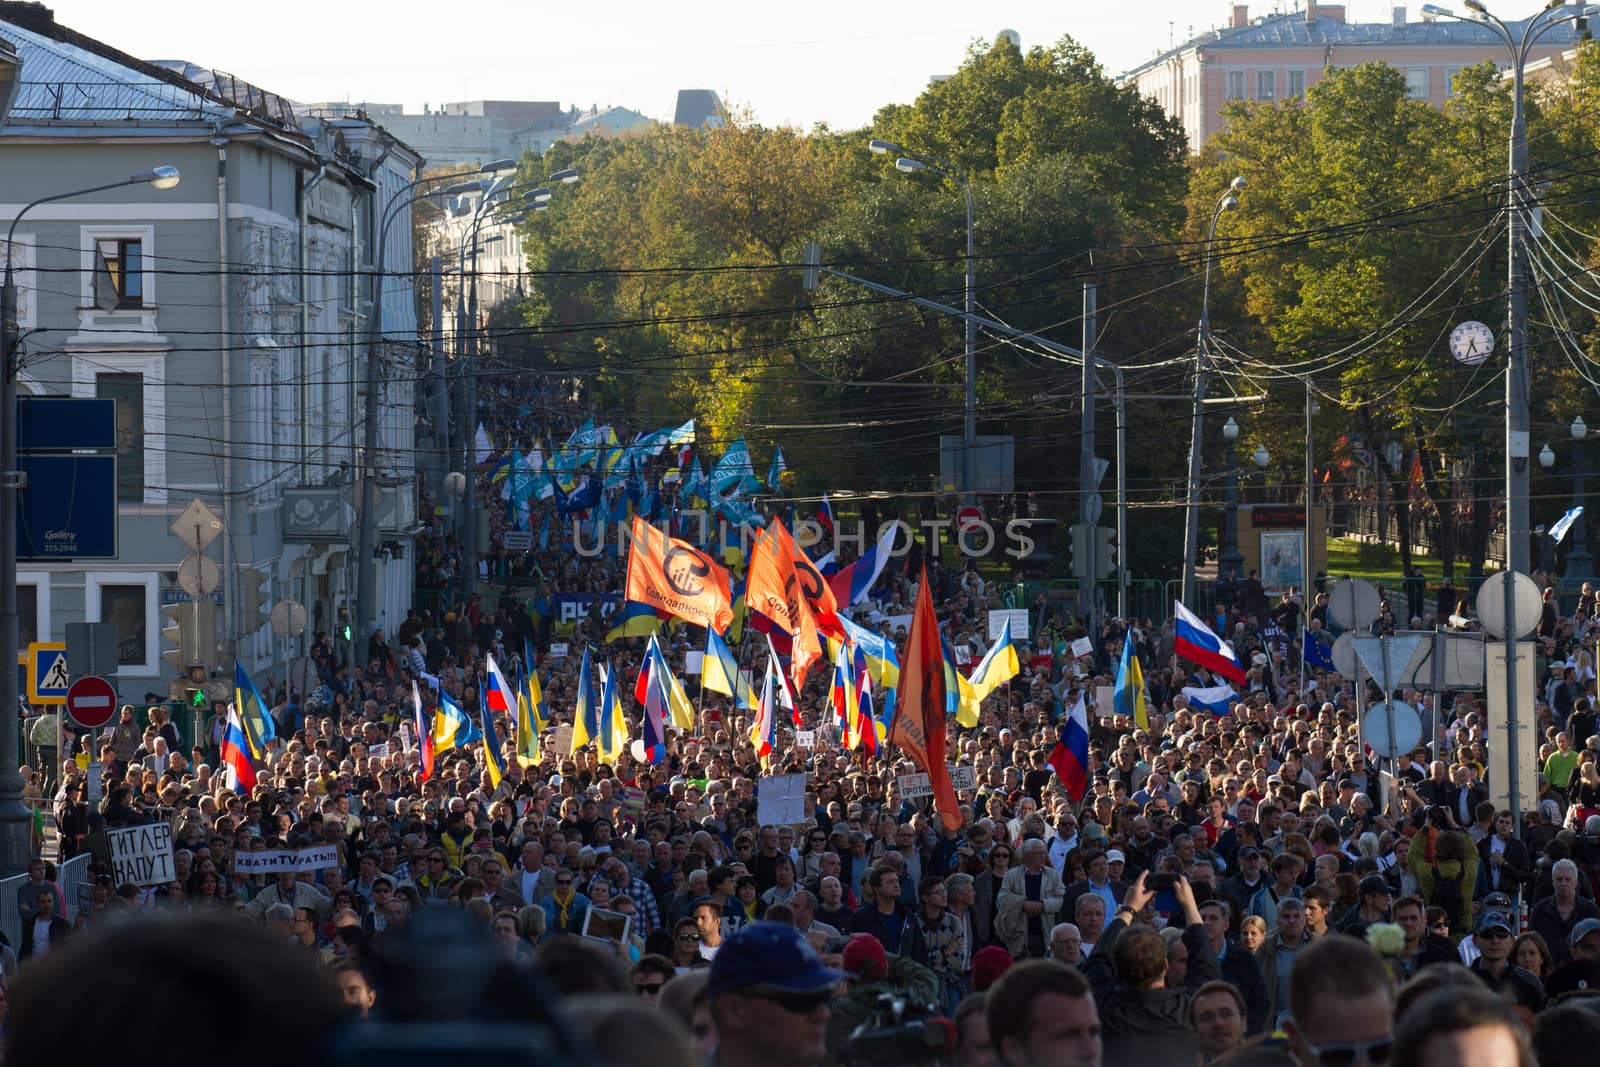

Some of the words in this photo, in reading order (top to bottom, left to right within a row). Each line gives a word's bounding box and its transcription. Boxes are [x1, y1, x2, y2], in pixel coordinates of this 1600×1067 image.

[901, 776, 924, 788] НЕТ
[108, 825, 170, 857] ГИТЛЕР
[113, 853, 169, 885] КАПУТ
